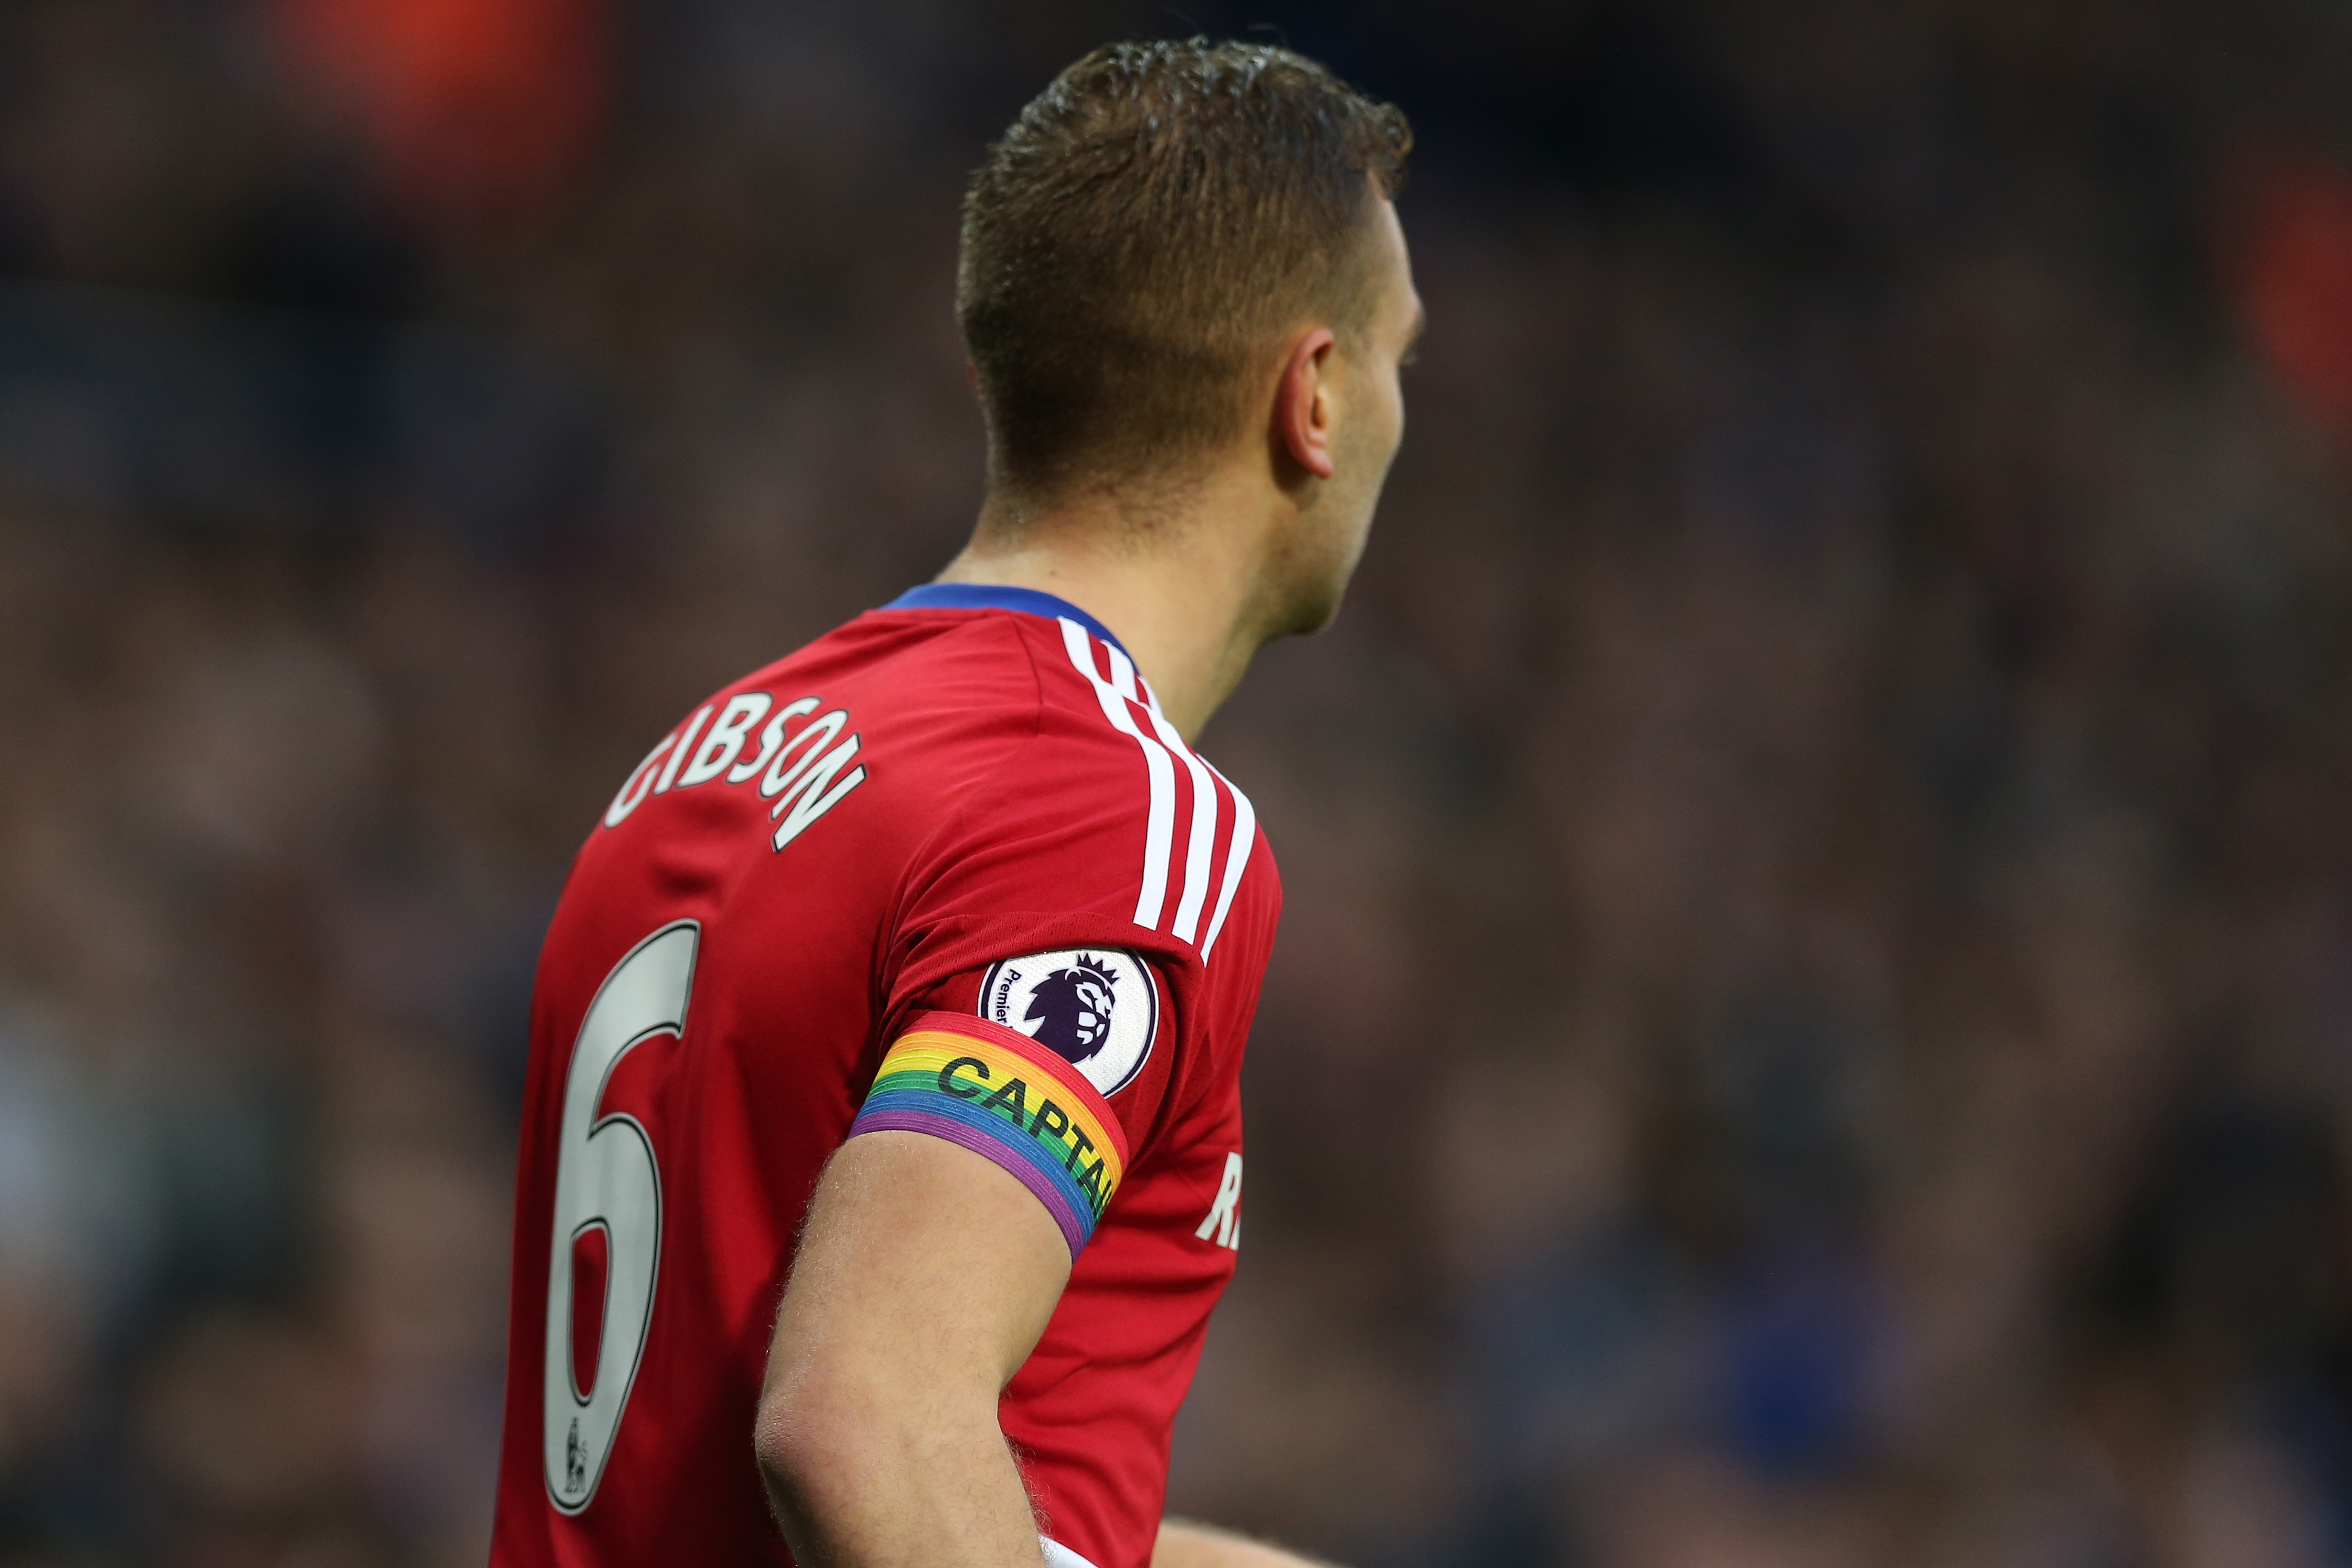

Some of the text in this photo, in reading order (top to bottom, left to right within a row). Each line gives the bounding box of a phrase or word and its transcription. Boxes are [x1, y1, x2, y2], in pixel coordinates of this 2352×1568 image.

[604, 691, 866, 853] GIBSON
[996, 969, 1022, 1023] Premier
[545, 919, 701, 1516] 6
[937, 1056, 1113, 1227] CAPTAI
[1194, 1151, 1243, 1252] R
